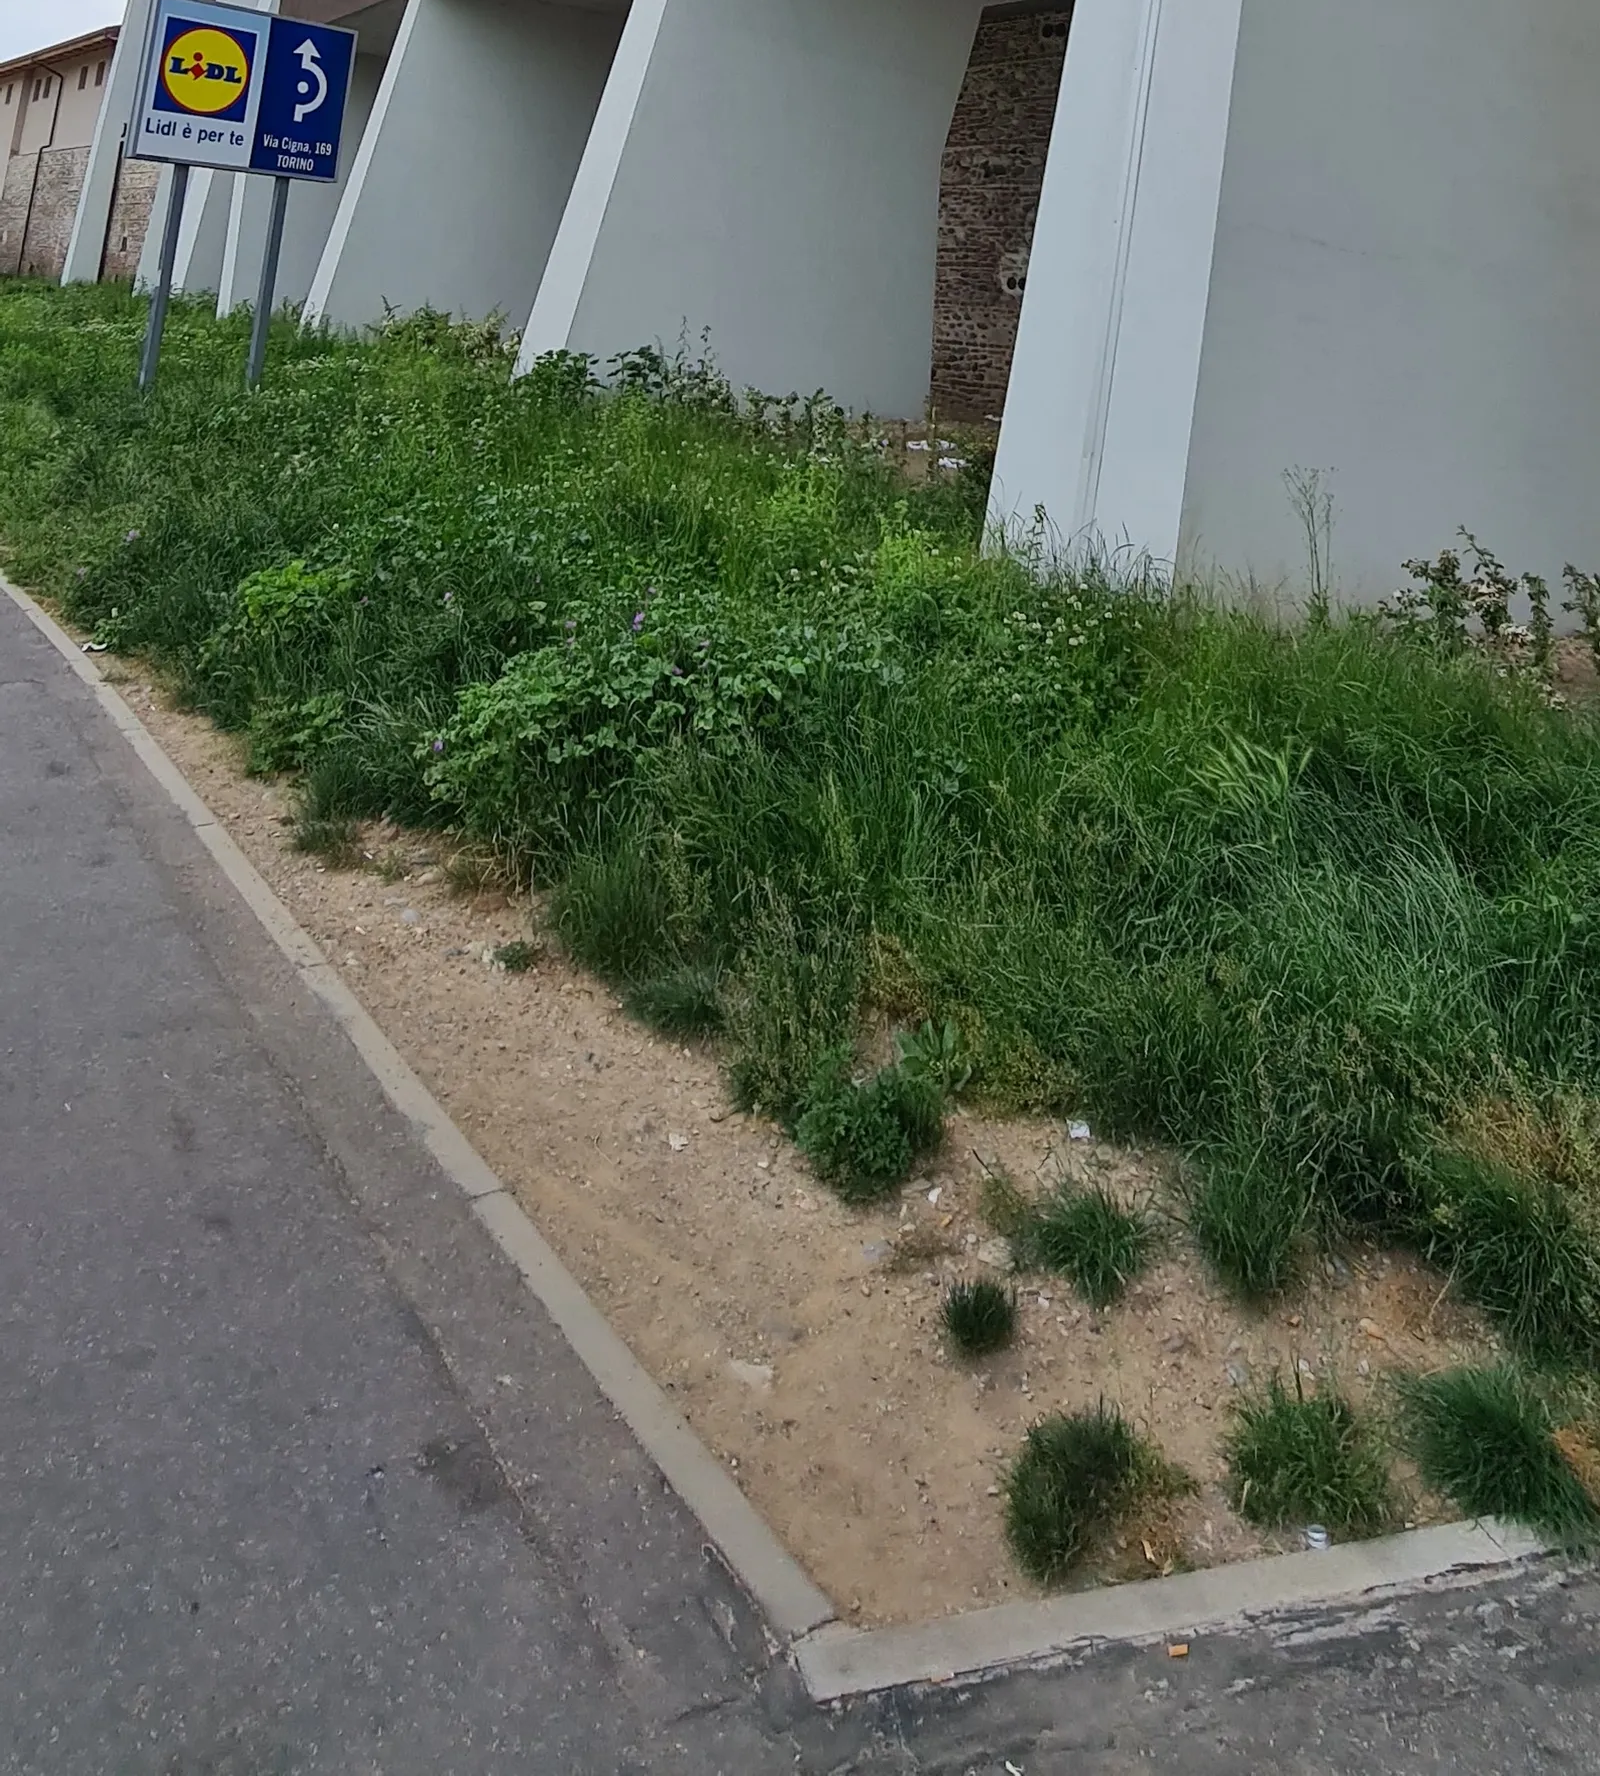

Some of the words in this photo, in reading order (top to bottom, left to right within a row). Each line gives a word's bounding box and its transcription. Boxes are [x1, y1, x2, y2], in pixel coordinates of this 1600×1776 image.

[145, 117, 177, 136] Lidl
[182, 123, 192, 138] è
[197, 129, 224, 144] per
[229, 131, 244, 146] te
[263, 134, 279, 148] Via
[281, 136, 311, 154] Cigna,
[315, 142, 332, 156] 169
[277, 154, 314, 171] TORINO
